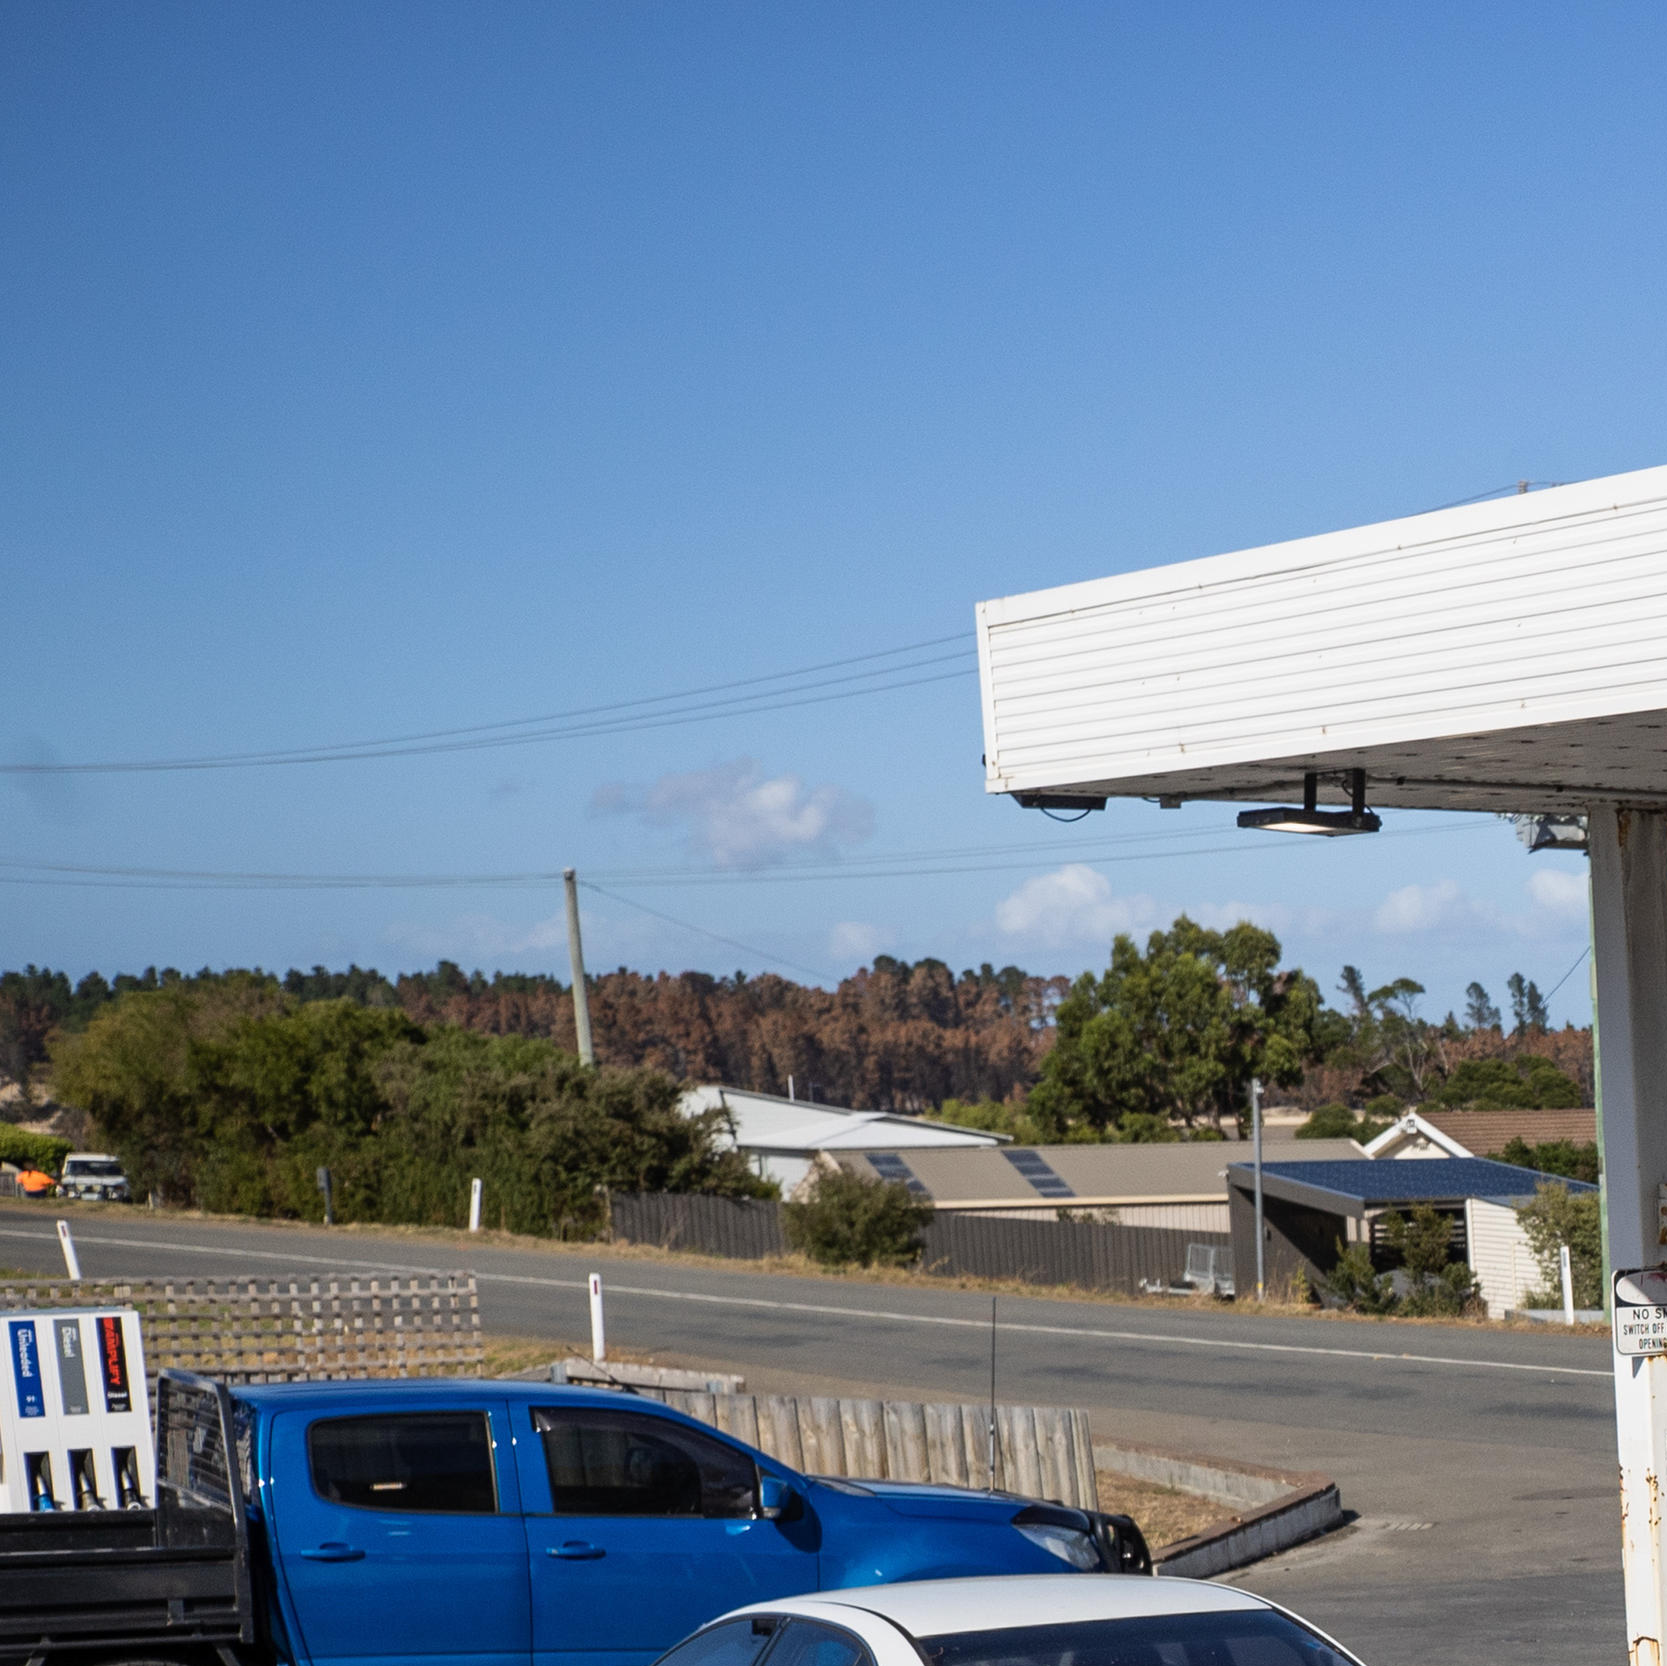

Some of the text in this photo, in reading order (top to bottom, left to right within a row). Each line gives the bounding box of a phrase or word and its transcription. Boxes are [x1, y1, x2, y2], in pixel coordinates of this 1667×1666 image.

[1632, 1308, 1650, 1320] NO
[1623, 1323, 1649, 1336] SWITCH
[1652, 1322, 1665, 1334] OFF
